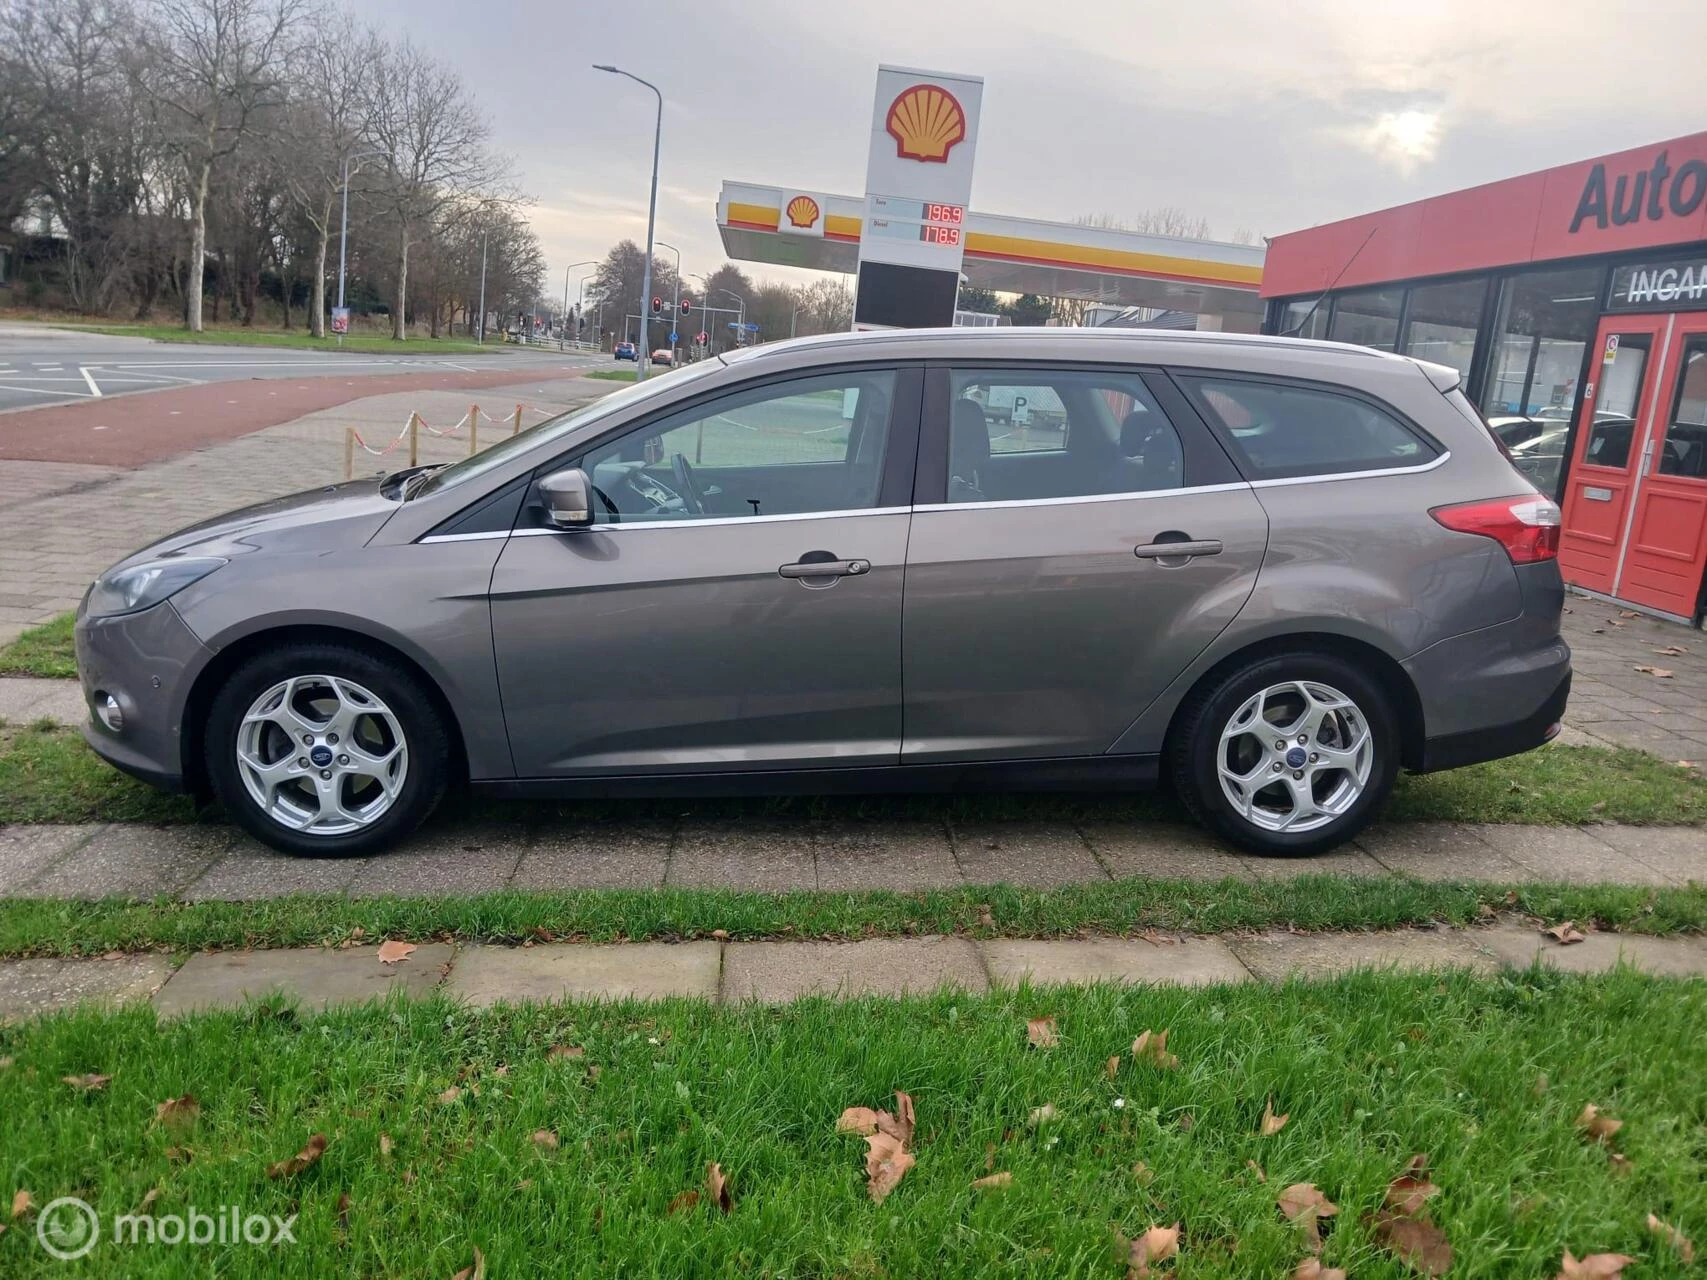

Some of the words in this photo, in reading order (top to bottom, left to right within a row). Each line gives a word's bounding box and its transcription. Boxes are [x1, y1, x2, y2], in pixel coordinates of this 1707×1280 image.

[928, 204, 962, 223] 196.9
[925, 226, 959, 245] 178.9
[1014, 396, 1028, 413] P
